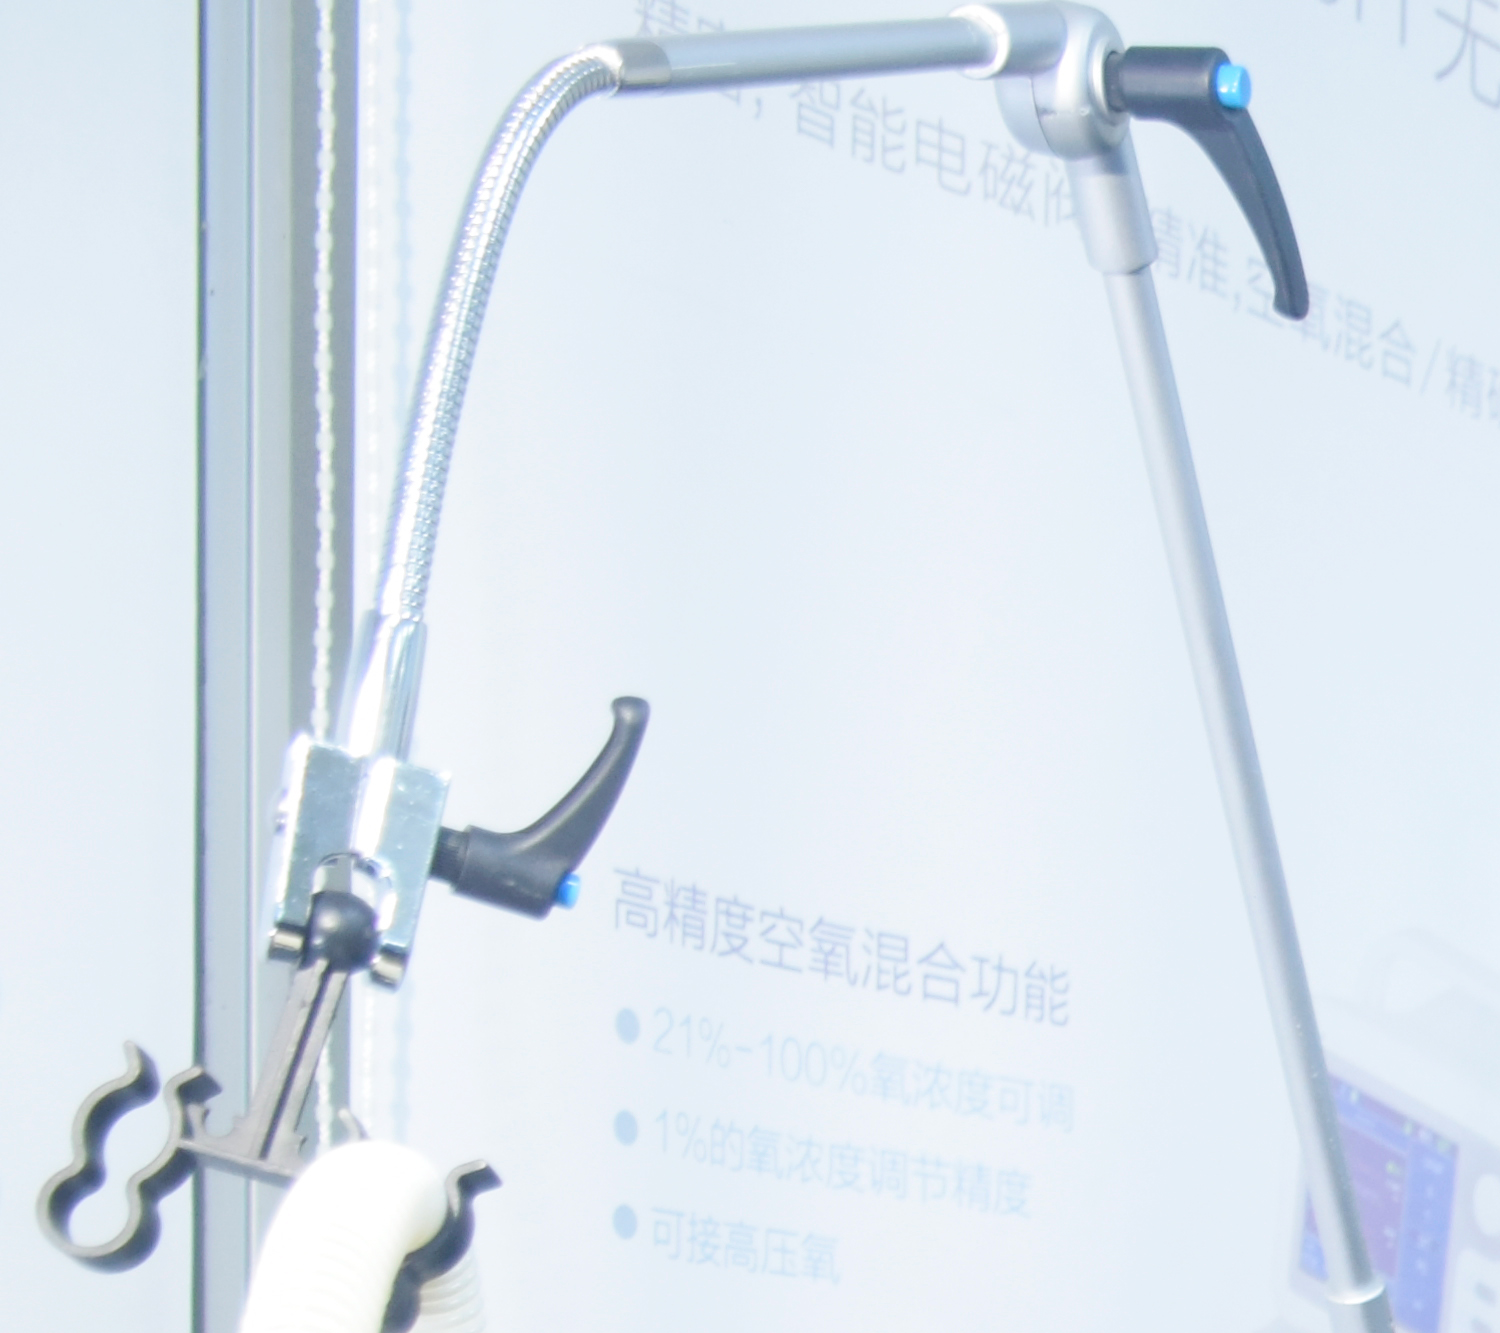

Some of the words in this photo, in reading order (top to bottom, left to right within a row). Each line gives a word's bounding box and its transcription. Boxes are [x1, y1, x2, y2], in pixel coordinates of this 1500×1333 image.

[612, 866, 1071, 1027] 高精度空氧混合功能
[652, 1005, 1075, 1135] 21%-100%氧浓度可调
[653, 1109, 1033, 1220] 1%的氧浓度调节精度
[650, 1206, 842, 1286] 可接高压氧
